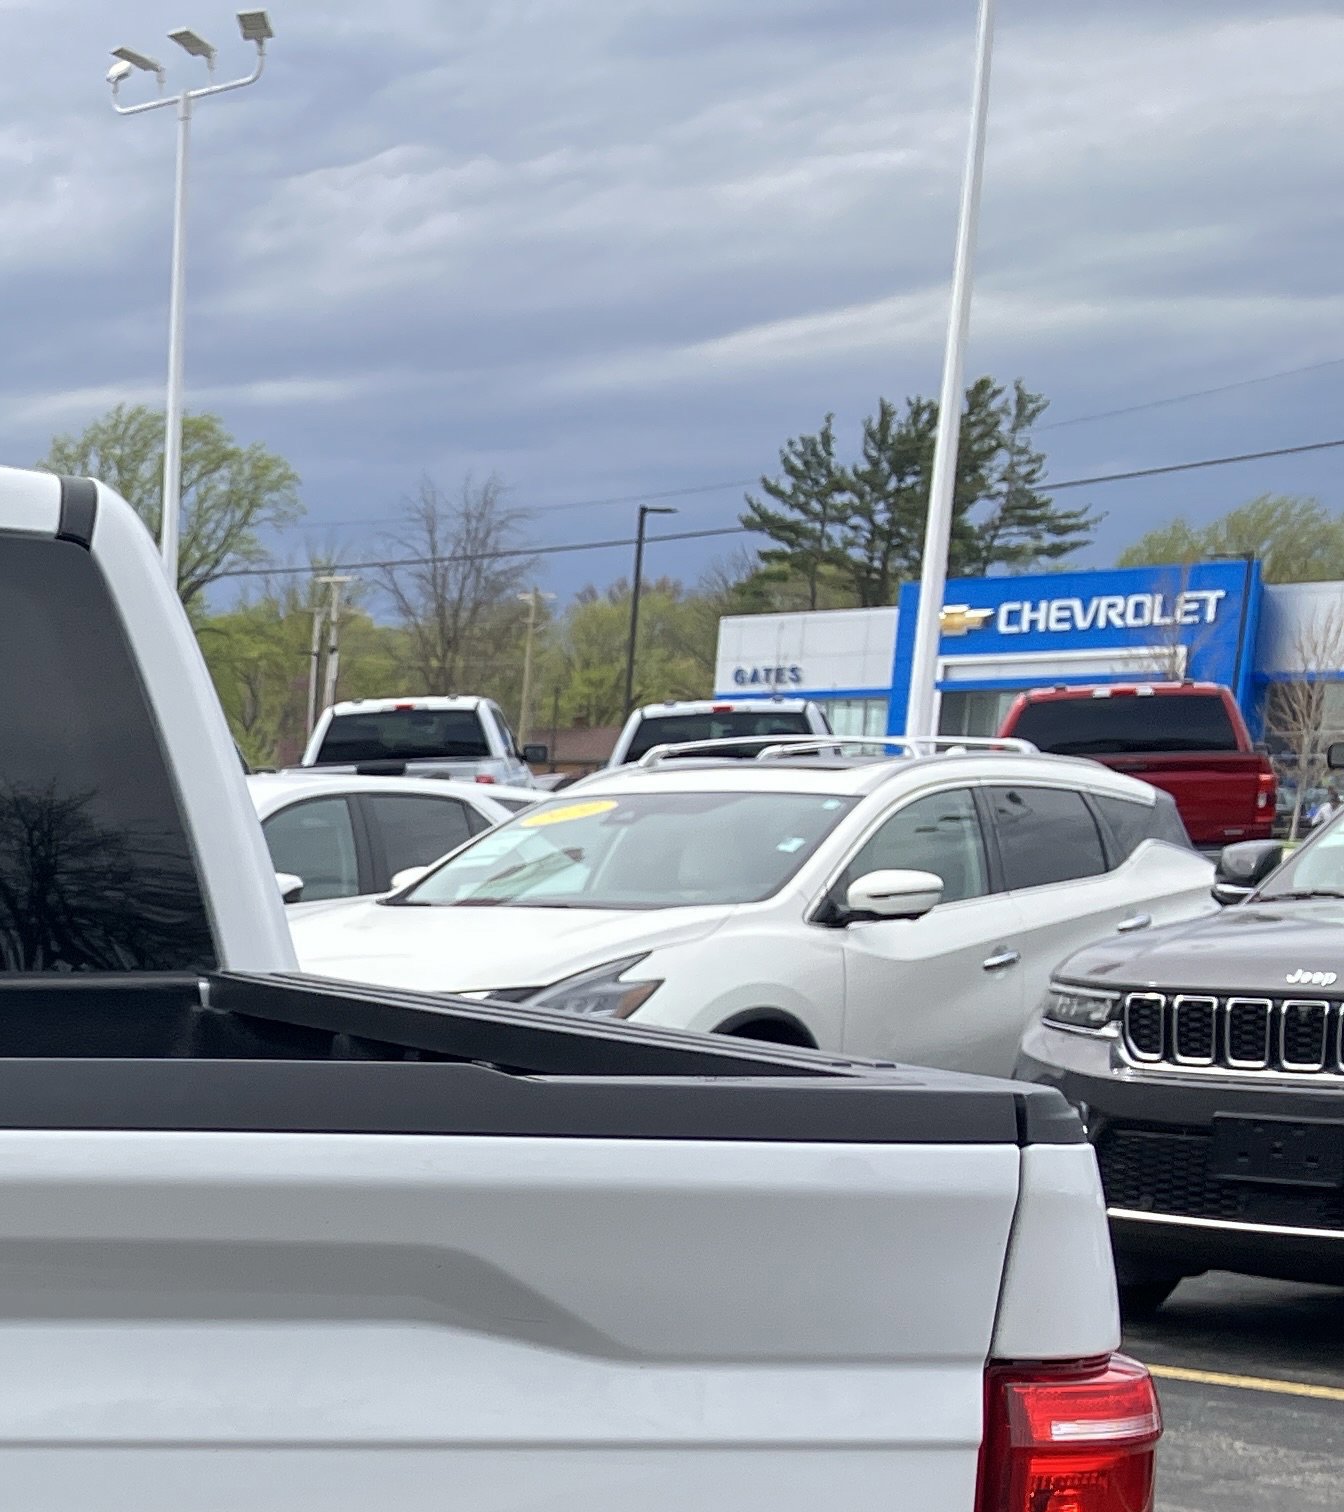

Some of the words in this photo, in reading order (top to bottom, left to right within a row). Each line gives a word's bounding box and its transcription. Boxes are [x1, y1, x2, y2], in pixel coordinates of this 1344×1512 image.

[997, 591, 1226, 635] CHEVROLET
[733, 666, 802, 686] GATES
[1286, 968, 1337, 987] Jeep
